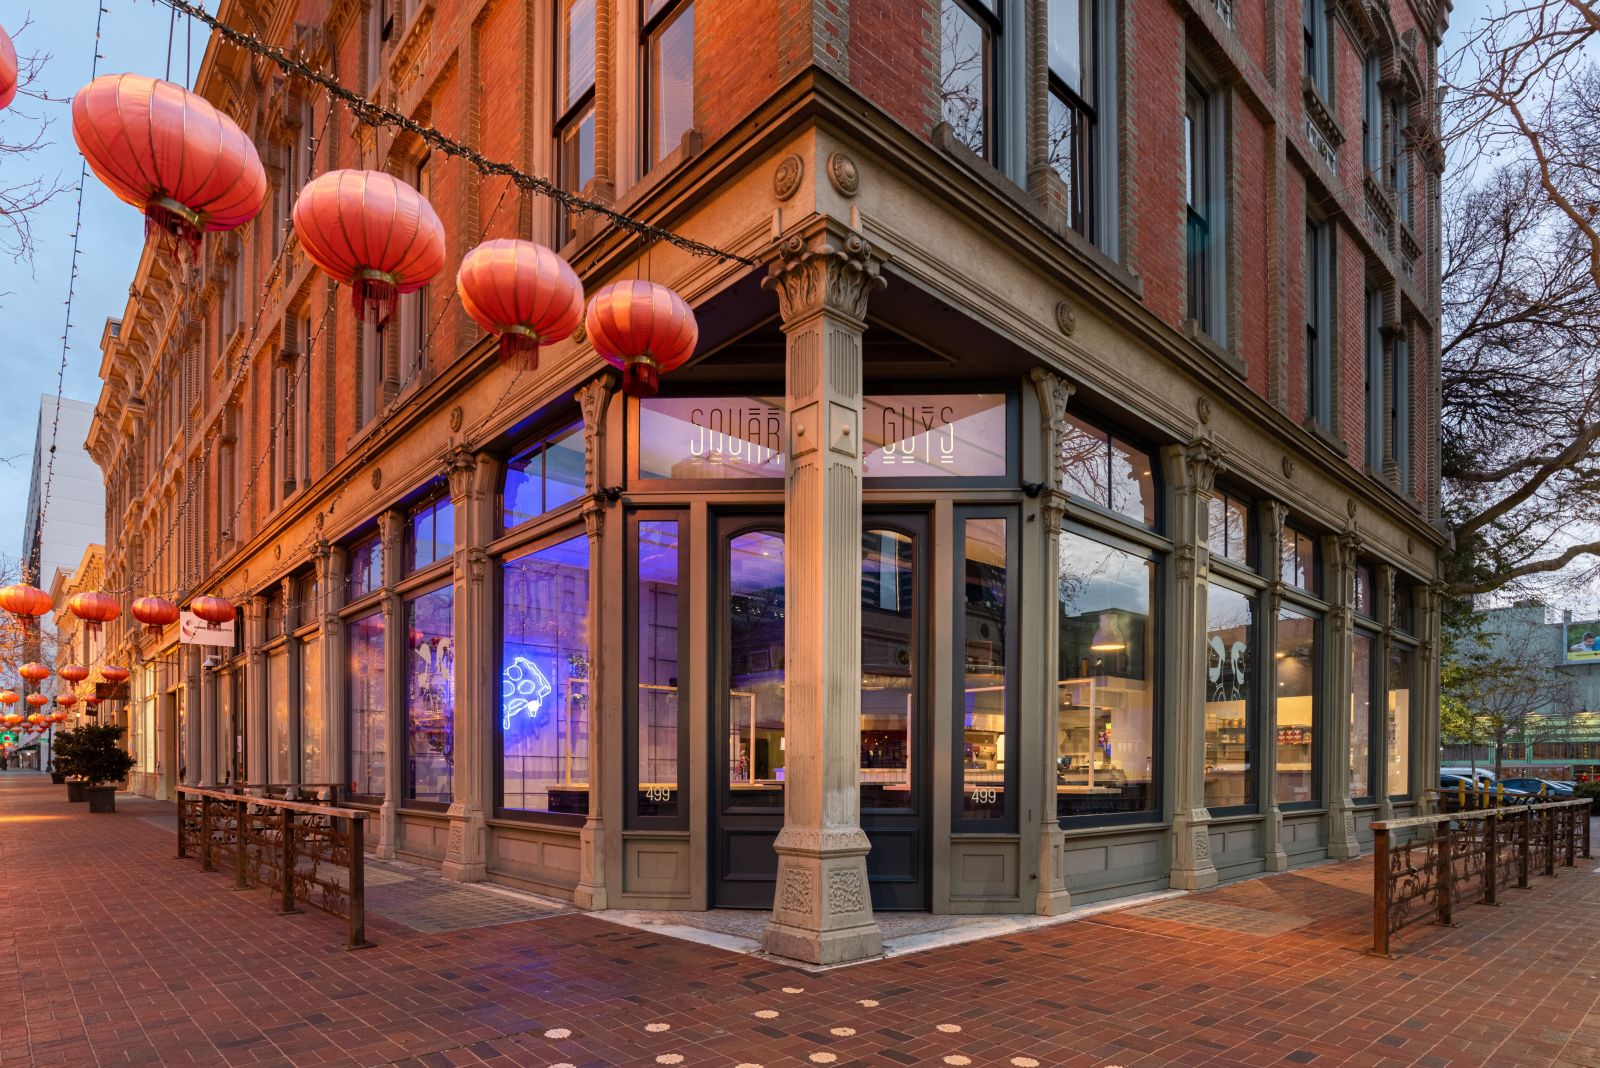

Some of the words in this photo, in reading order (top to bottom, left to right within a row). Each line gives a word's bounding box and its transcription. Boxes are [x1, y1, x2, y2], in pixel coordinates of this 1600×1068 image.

[690, 407, 780, 465] SQUAR
[882, 406, 954, 464] GUYS
[646, 786, 670, 802] 499
[971, 788, 996, 804] 499
